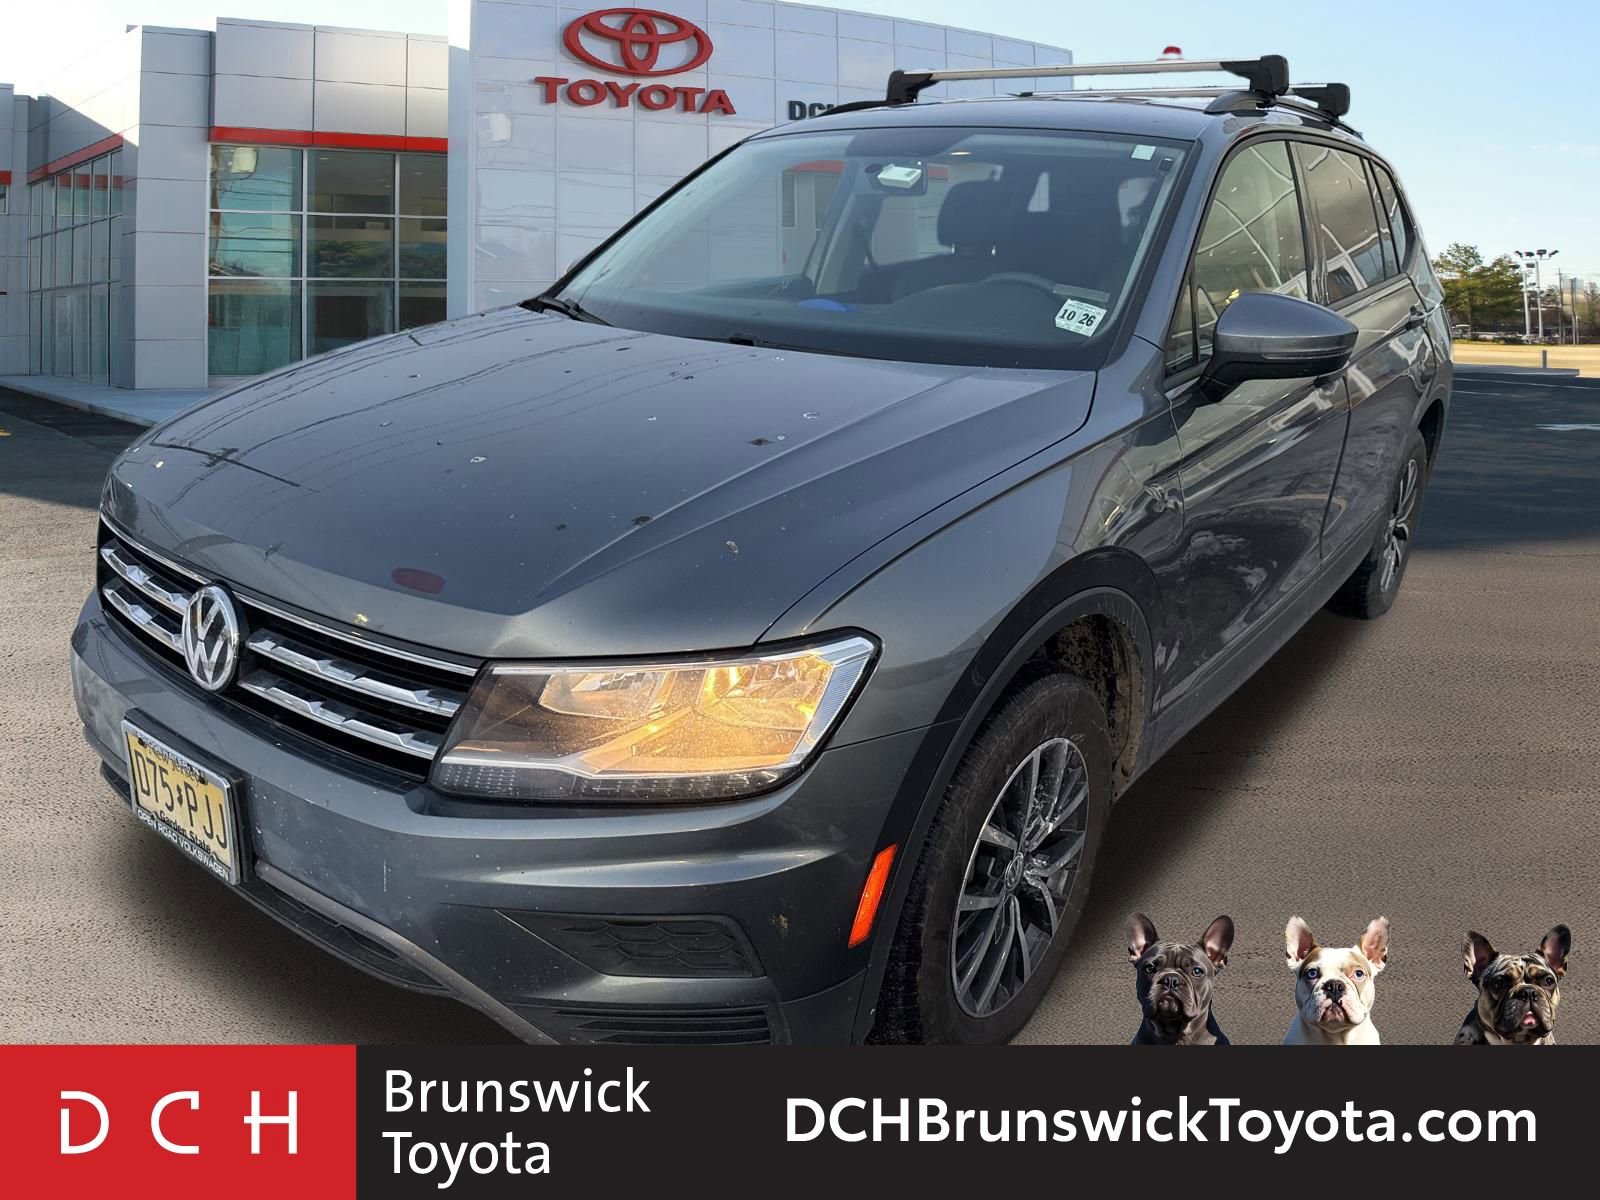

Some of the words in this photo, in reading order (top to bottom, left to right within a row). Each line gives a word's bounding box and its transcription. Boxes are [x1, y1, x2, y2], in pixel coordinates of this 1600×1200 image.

[534, 76, 737, 115] TOYOTA
[788, 100, 835, 120] DC
[1060, 309, 1076, 321] 10
[1078, 313, 1096, 327] 26
[137, 809, 158, 830] OPEN
[158, 823, 178, 844] ROAD
[179, 838, 229, 881] VOLKSWAGEN
[159, 809, 187, 836] Garden
[189, 828, 211, 854] State
